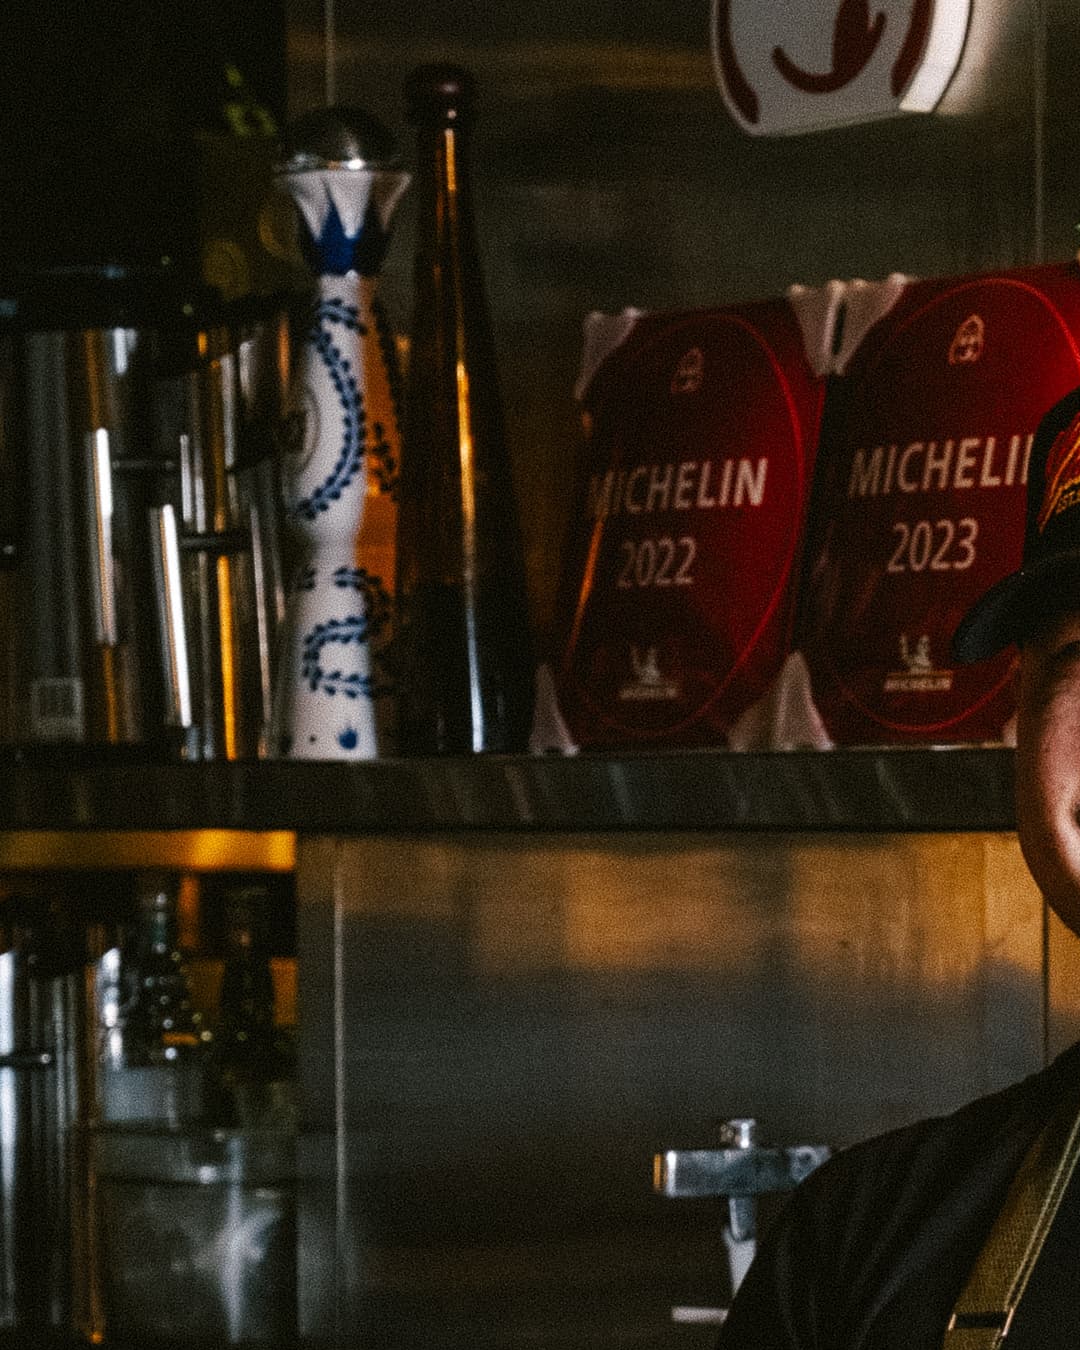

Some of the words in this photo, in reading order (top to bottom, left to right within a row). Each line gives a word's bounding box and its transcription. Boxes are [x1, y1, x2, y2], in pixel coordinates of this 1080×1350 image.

[588, 457, 768, 518] MICHELIN
[617, 536, 698, 589] 2022
[887, 517, 979, 573] 2023
